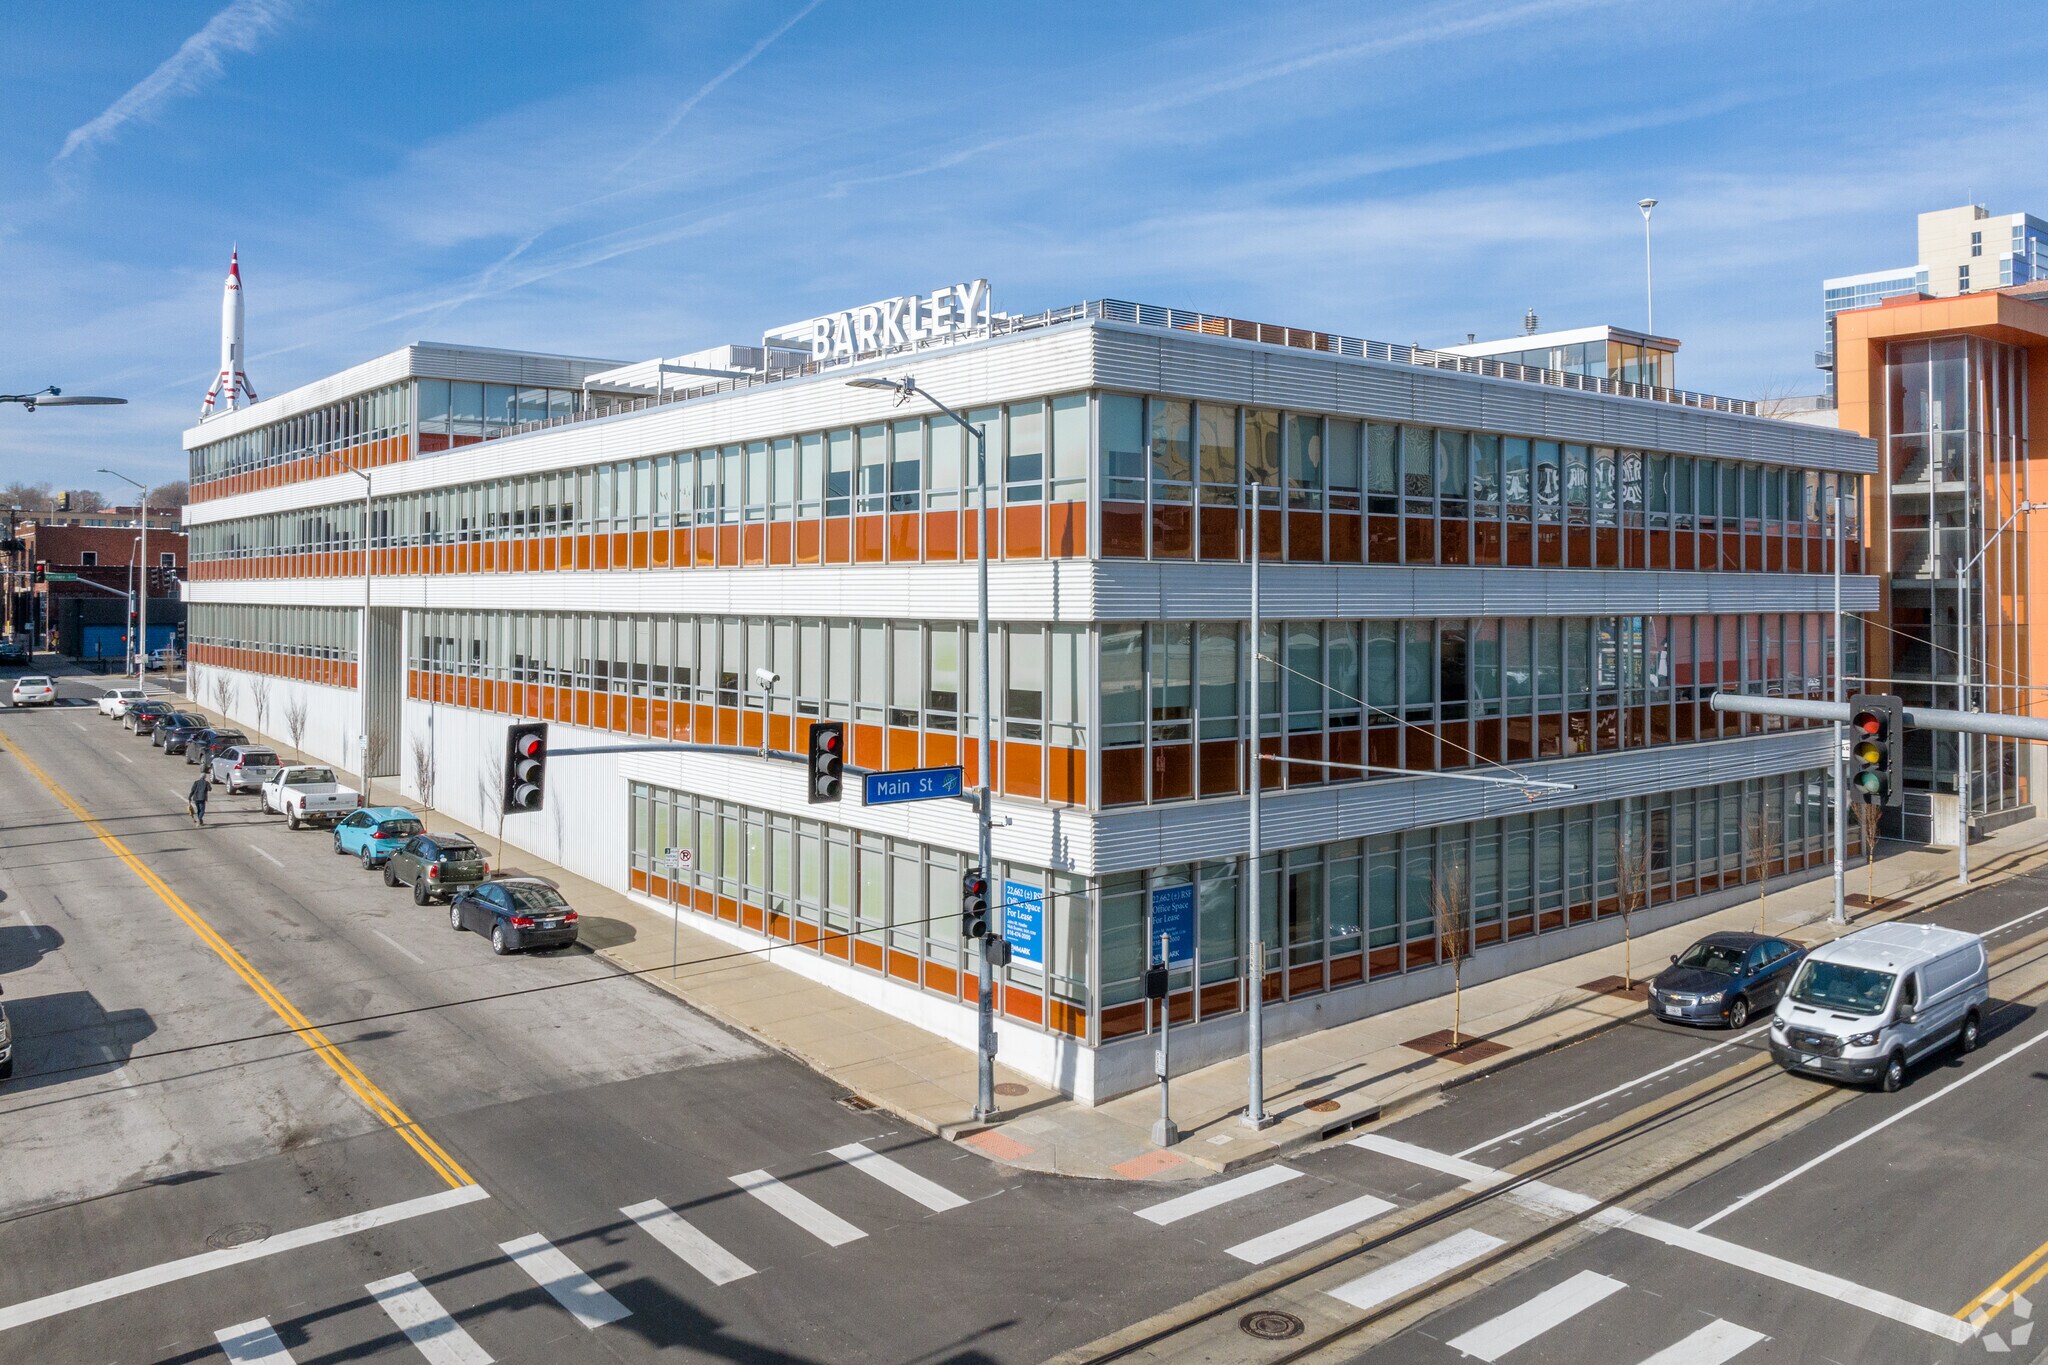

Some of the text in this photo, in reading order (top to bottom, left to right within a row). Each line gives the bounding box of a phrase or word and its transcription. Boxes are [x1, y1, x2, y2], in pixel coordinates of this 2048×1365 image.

[812, 279, 988, 361] BARKLEY
[878, 778, 933, 795] Main St
[1007, 886, 1023, 897] 22,662
[1181, 890, 1191, 898] RSF
[1007, 897, 1041, 912] Office Space
[1153, 902, 1188, 913] Office Space
[1007, 908, 1032, 921] For Lease
[1164, 914, 1179, 922] Lease
